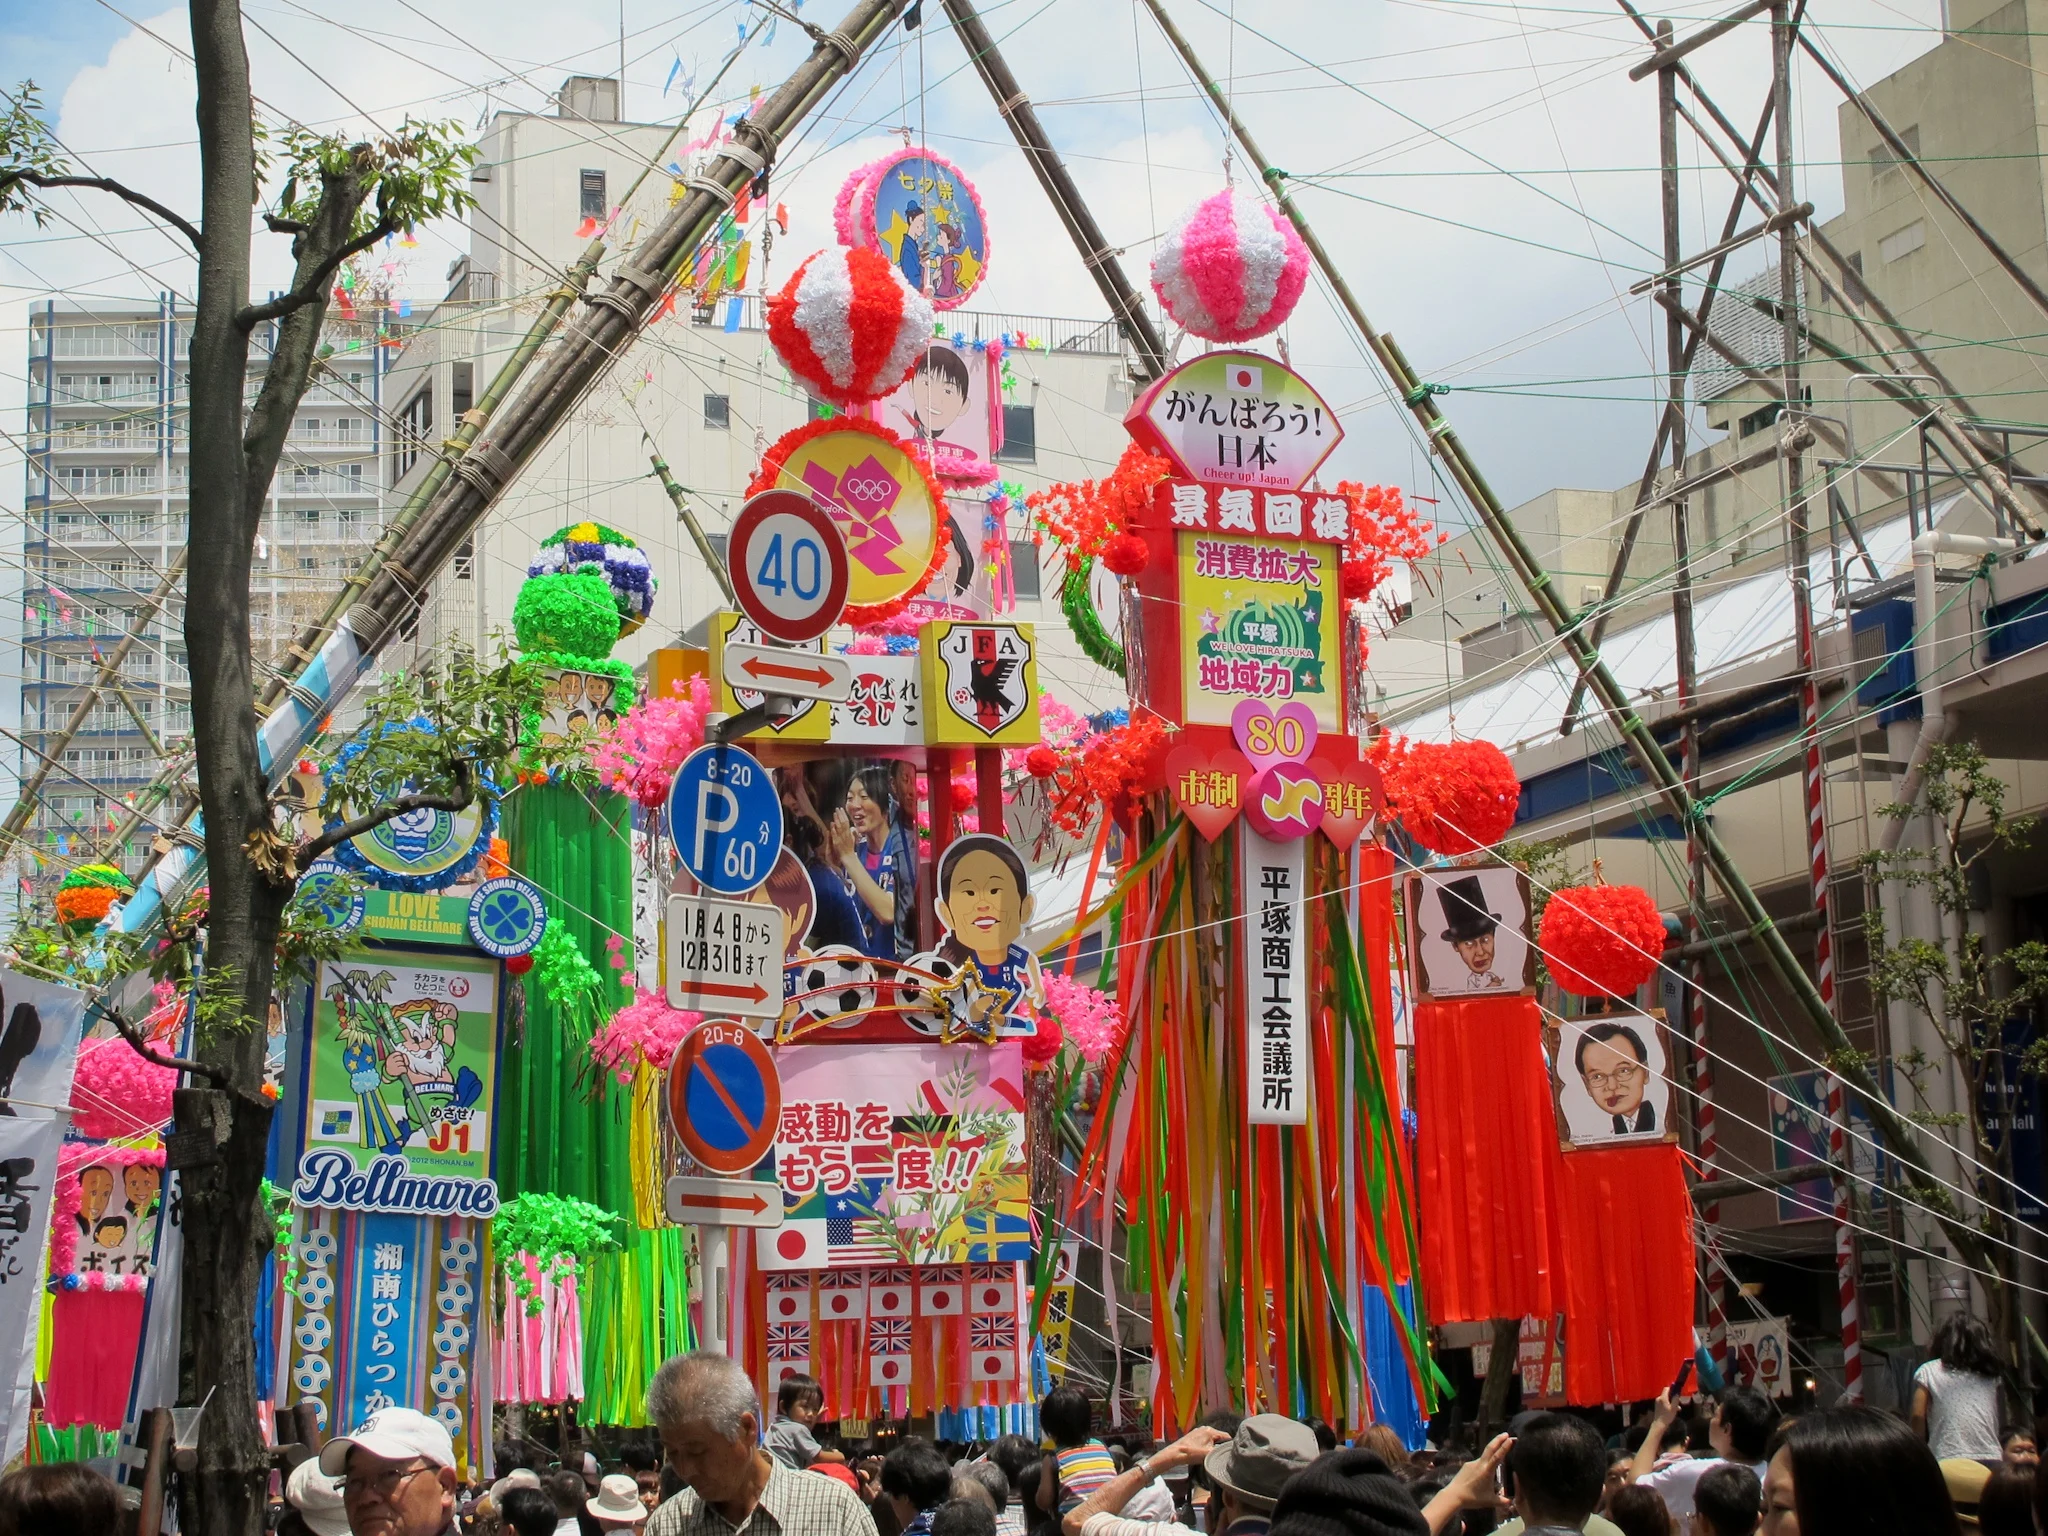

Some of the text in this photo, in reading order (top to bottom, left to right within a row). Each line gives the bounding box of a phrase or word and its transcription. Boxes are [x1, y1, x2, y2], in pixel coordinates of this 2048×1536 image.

[897, 171, 954, 200] 七夕祭
[1165, 390, 1321, 436] がんばろう!
[1217, 434, 1278, 470] 日本
[1203, 467, 1290, 486] Cheer up! Japan
[1170, 483, 1349, 541] 景気回復
[757, 533, 821, 600] 40
[1195, 541, 1321, 584] 消費拡大
[953, 635, 1017, 655] JFA
[1242, 622, 1278, 643] 平塚
[1210, 641, 1314, 658] WE LOVE HIRATSUKA
[850, 678, 919, 701] んばれ
[1199, 655, 1294, 699] 地域力
[1247, 715, 1304, 756] 80
[706, 757, 751, 787] 8-20
[1177, 769, 1239, 808] 市制
[694, 779, 739, 871] P
[758, 820, 770, 846] 分
[723, 837, 756, 881] 60
[388, 893, 441, 921] LOVE
[470, 879, 544, 919] LOVE SHONAN BELLMARE
[364, 915, 407, 931] SHONAN
[409, 919, 462, 935] BELLMARE
[469, 915, 544, 955] LOVE SHONAN BELLMARE
[414, 973, 446, 984] チカラを
[1260, 866, 1293, 1112] 平塚商工会議所
[702, 1026, 744, 1046] 20-8
[414, 1083, 455, 1094] BELLMARE
[430, 1106, 475, 1121] めざせ!
[777, 1101, 890, 1145] 感動を
[429, 1123, 469, 1153] J1
[298, 1150, 497, 1216] Bellmare
[779, 1147, 980, 1193] もう一度!!
[80, 1251, 150, 1275] ボイス
